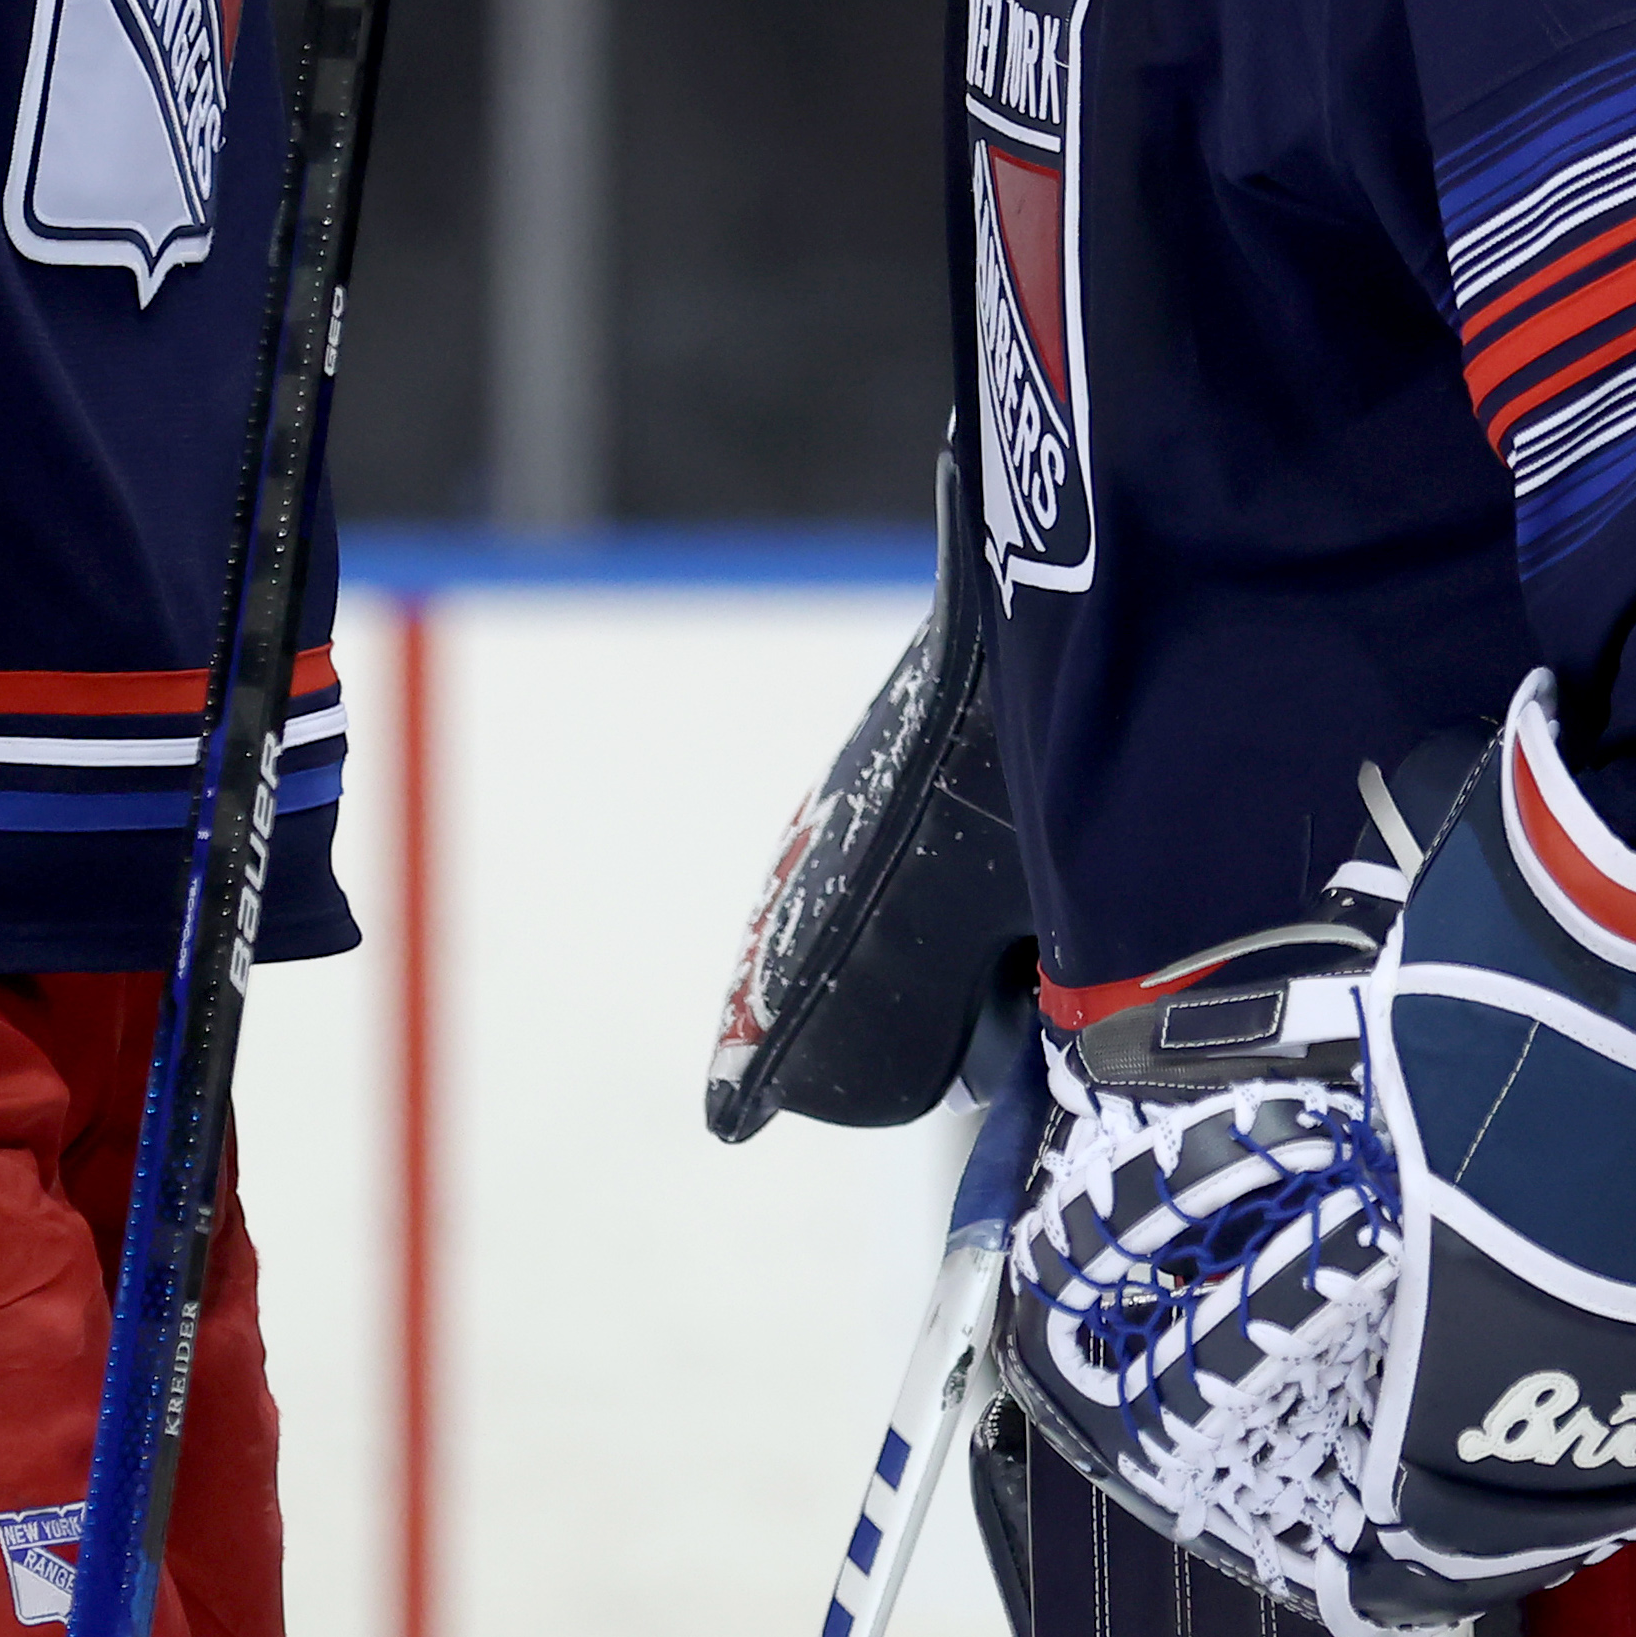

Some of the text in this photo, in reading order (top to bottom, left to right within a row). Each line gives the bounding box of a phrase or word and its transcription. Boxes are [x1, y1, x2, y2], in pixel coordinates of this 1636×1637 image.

[1001, 0, 1061, 125] YORK
[164, 1301, 199, 1437] KREIDER
[3, 1516, 83, 1545] NEW YORK
